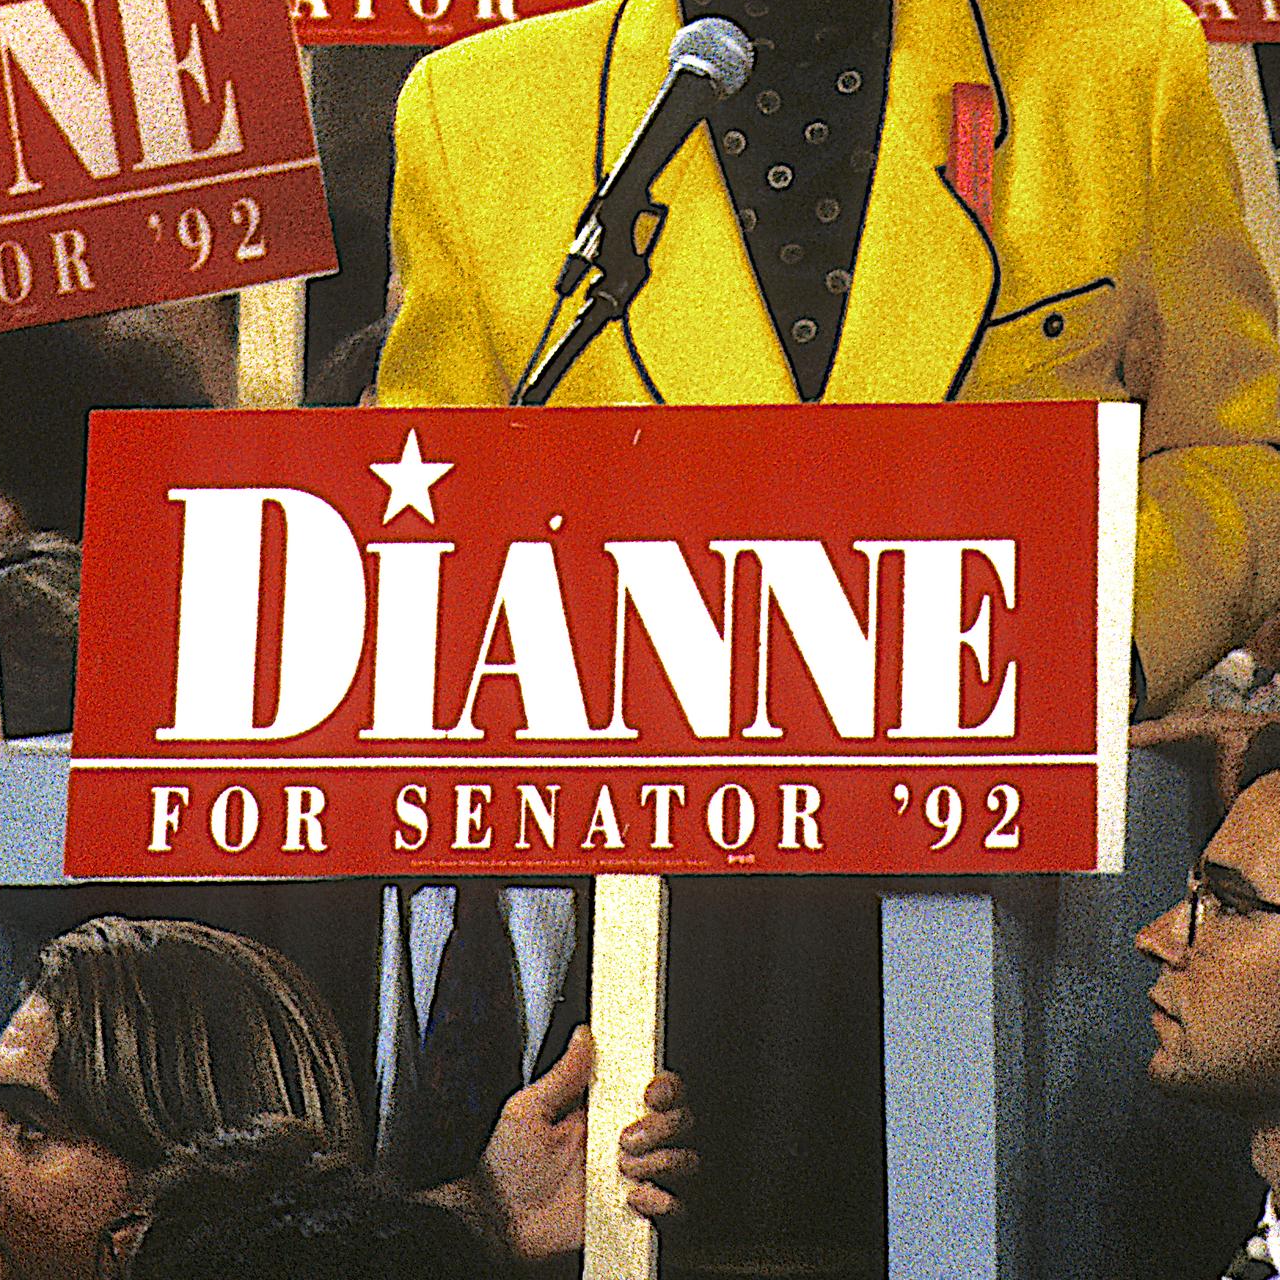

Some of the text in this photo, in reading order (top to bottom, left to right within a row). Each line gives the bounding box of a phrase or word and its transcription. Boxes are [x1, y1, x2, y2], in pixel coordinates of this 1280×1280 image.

[148, 197, 268, 272] '92
[155, 485, 1019, 743] DIANNE
[146, 783, 1023, 853] FOR SENATOR '92
